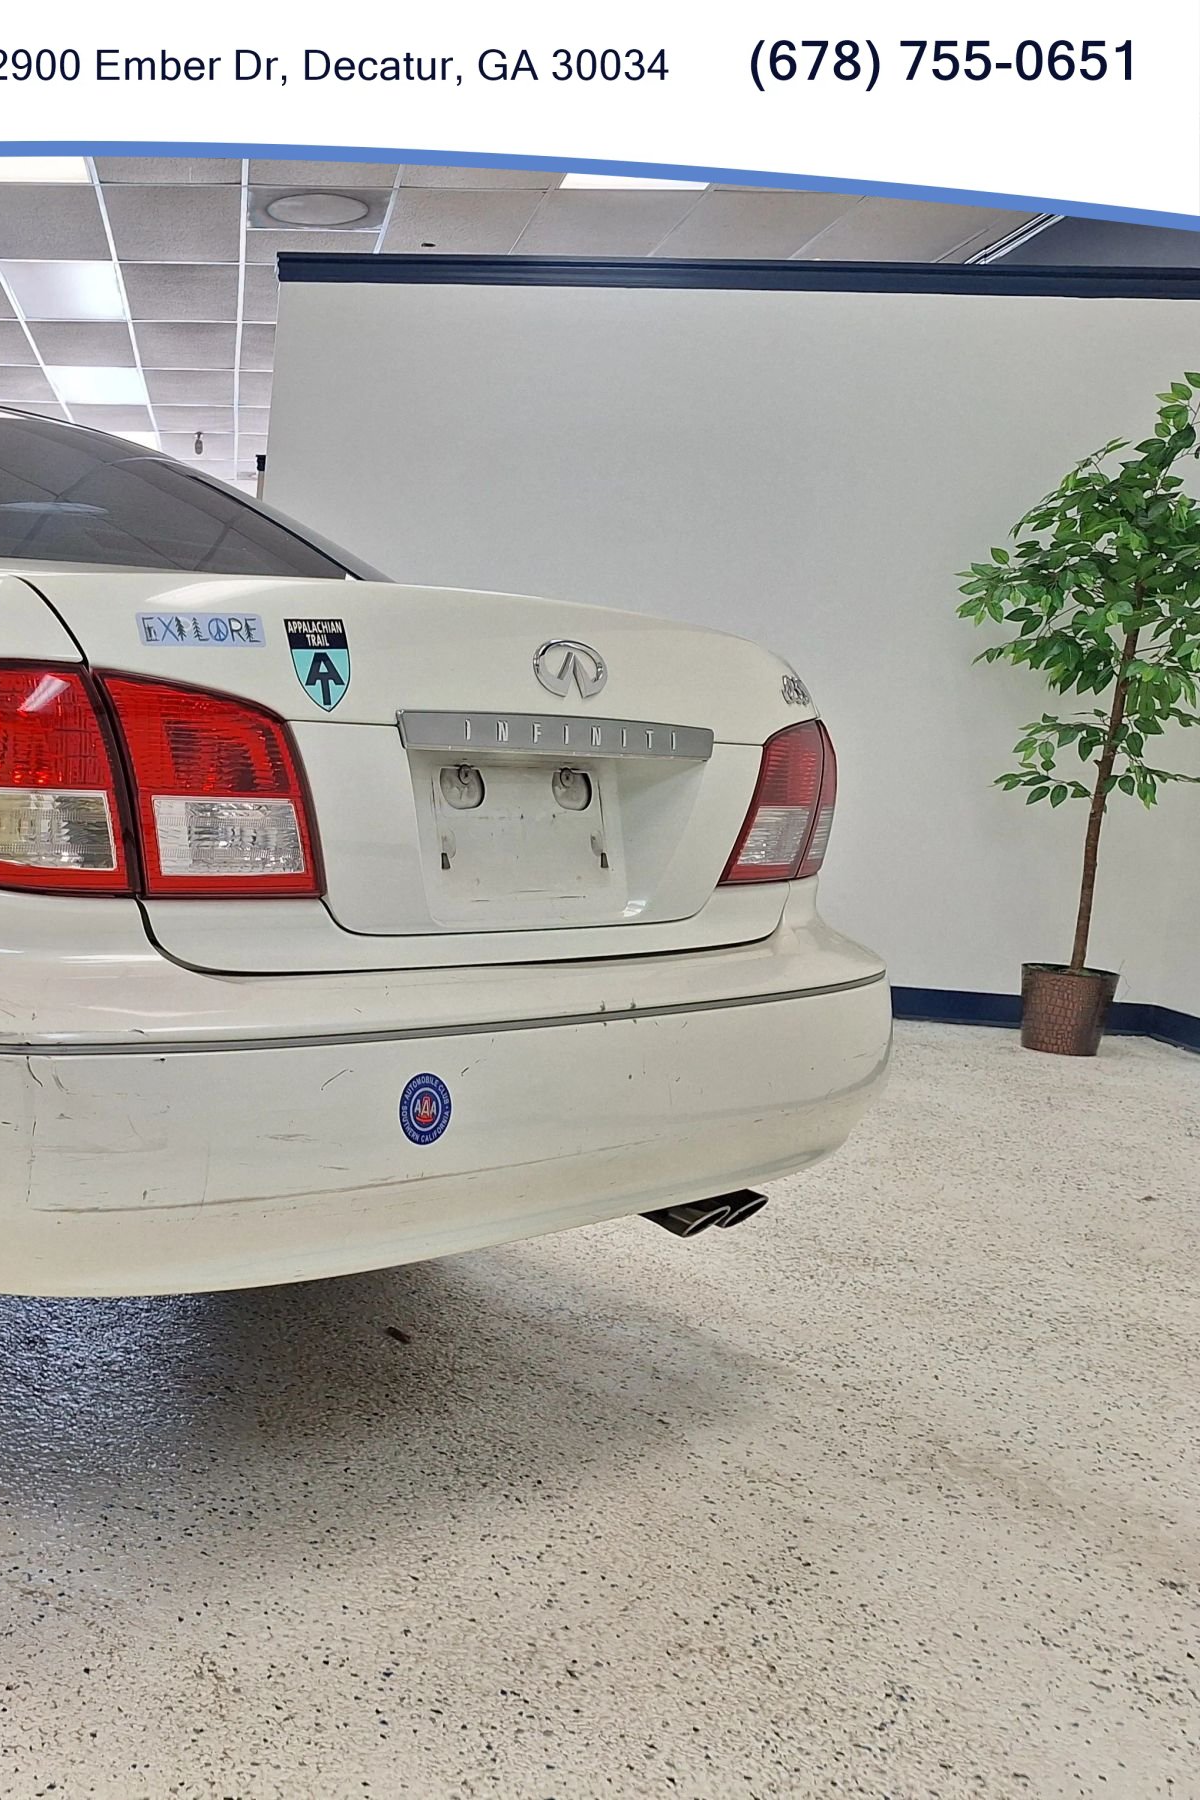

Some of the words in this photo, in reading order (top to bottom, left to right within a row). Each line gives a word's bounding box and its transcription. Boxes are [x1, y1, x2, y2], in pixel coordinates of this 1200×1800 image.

[142, 616, 261, 643] EXPLORE
[287, 620, 343, 634] APPALACHIAN
[306, 633, 330, 647] TRAIL
[463, 718, 677, 751] INFINITI
[404, 1075, 440, 1101] AUTOMOBILE
[438, 1084, 450, 1105] CLUB
[414, 1098, 437, 1117] AAA
[401, 1105, 420, 1142] SOUTHERN
[420, 1110, 450, 1143] CALIFORNIA
